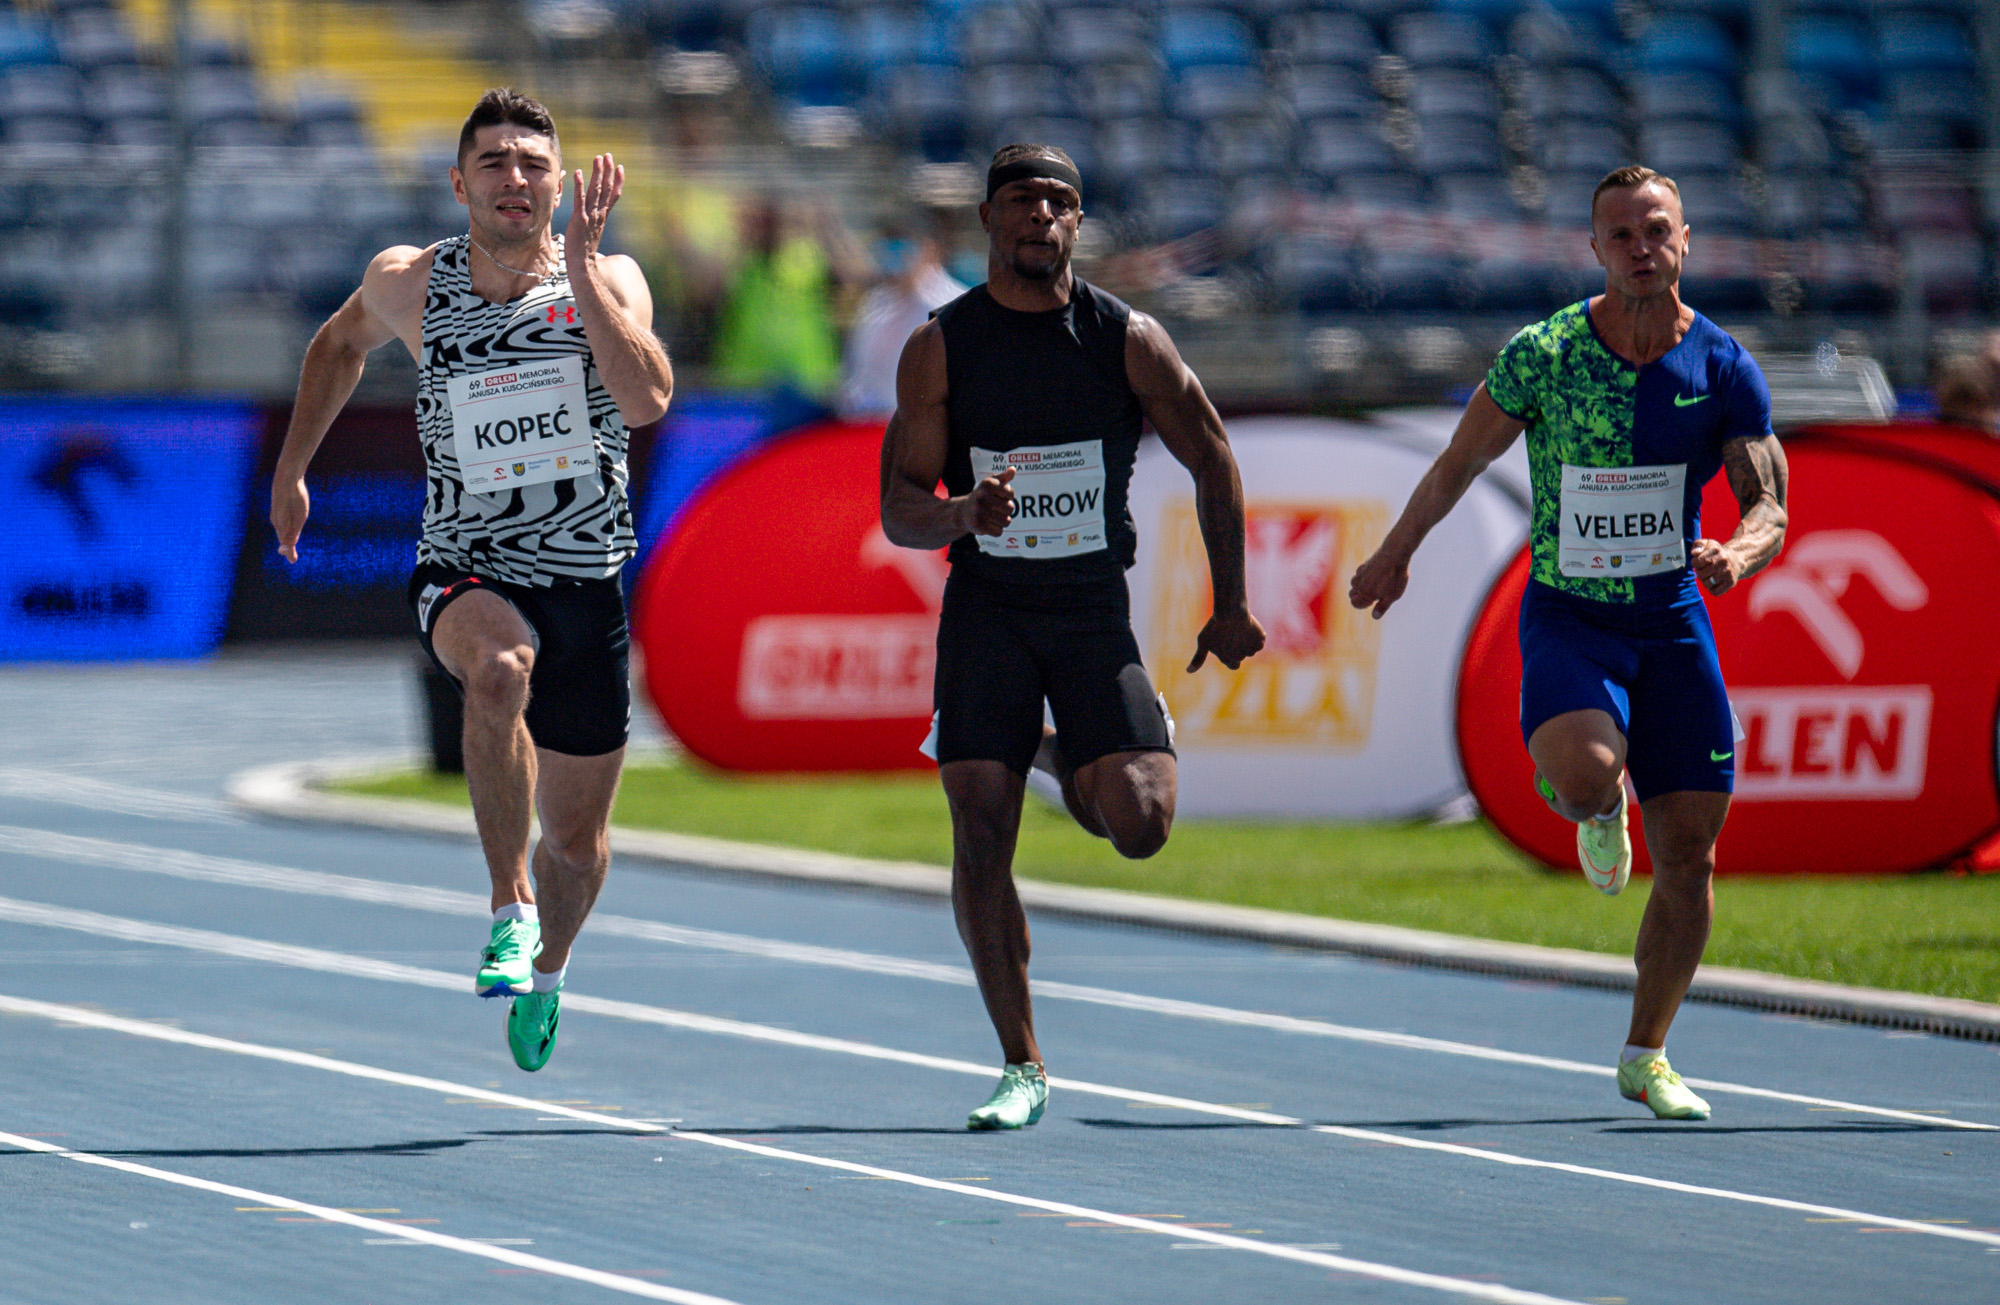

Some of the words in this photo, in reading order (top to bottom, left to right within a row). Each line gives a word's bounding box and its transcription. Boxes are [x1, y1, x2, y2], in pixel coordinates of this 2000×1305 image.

[486, 374, 516, 386] ORLEN
[519, 367, 561, 380] MEMORIAŁ
[468, 388, 501, 400] JANUSZA
[502, 376, 565, 393] KUSOCIŃSKIEGO
[474, 403, 572, 450] KOPEĆ
[1010, 454, 1039, 462] ORLEN
[1043, 450, 1082, 460] MEMORIAŁ
[1025, 458, 1085, 471] KUSOCIŃSKIEGO
[1578, 482, 1609, 491] JANUSZA
[1596, 474, 1626, 482] ORLEN
[1574, 509, 1675, 540] VELEBA
[1743, 708, 1905, 777] LEN
